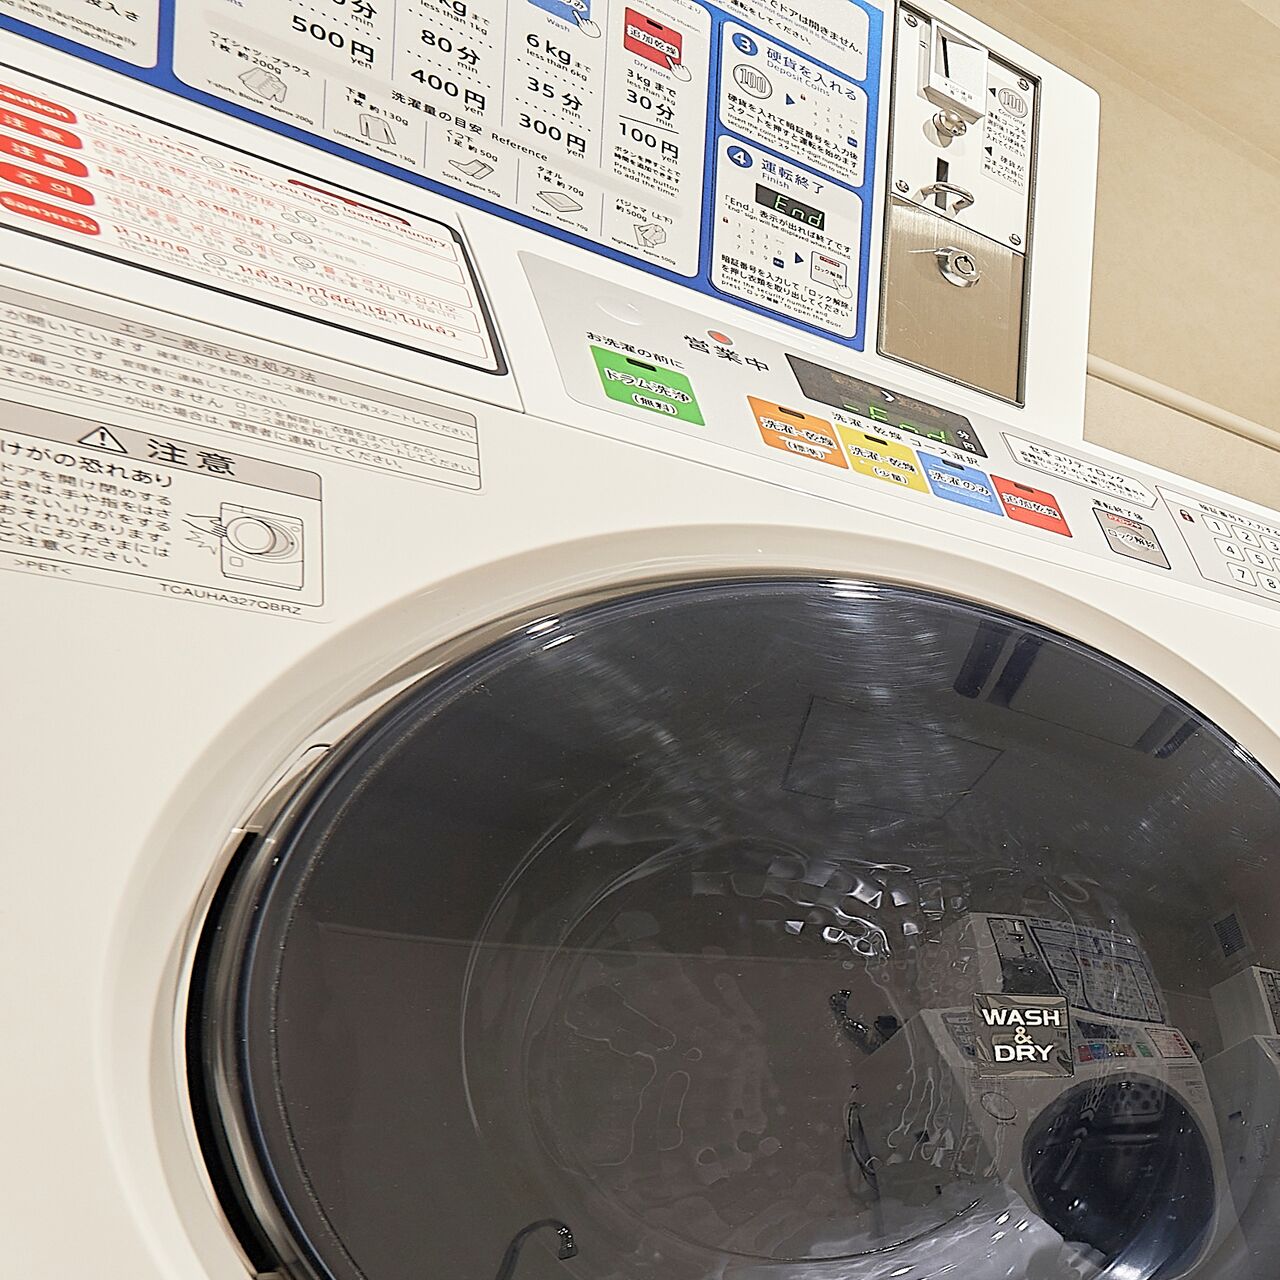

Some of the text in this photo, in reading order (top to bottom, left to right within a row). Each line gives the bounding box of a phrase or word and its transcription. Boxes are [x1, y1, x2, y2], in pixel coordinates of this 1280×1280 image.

[351, 14, 374, 28] min
[443, 12, 466, 24] than
[470, 22, 488, 36] 1kg
[546, 17, 570, 33] Wash
[628, 26, 677, 57] 追加乾燥
[351, 57, 372, 69] yen
[457, 60, 479, 74] min
[526, 48, 588, 81] less than 6kg
[634, 59, 671, 81] Dry more
[766, 47, 857, 101] 硬貨を入れる
[626, 78, 642, 90] less
[643, 84, 660, 98] than
[739, 68, 767, 94] 100
[767, 61, 830, 97] Deposit Coins
[464, 104, 484, 117] yen
[561, 106, 581, 119] min
[655, 116, 674, 129] min
[390, 89, 548, 162] 洗濯量の目安 Reference
[446, 129, 474, 143] くつ下
[566, 148, 585, 159] yen
[986, 134, 1026, 158] 入れてください
[614, 144, 682, 177] ボタンを押すことで
[661, 154, 679, 165] yen
[83, 113, 447, 249] Do not press after you have loaded laundry
[537, 165, 562, 180] タオル
[613, 168, 622, 176] to
[625, 174, 640, 182] add
[642, 180, 655, 189] the
[638, 171, 651, 180] the
[653, 178, 680, 193] button
[761, 158, 825, 194] 運転終了
[762, 172, 790, 190] Finish
[984, 164, 1024, 187] 押してください
[773, 194, 823, 228] End
[814, 264, 843, 280] ロック解除
[721, 264, 849, 318] を押し衣類を取り出してください
[721, 273, 829, 318] Enter the security number and
[118, 322, 318, 384] エラー表示と対処方法
[586, 331, 685, 370] お洗濯の前に
[684, 335, 769, 371] 営業中
[606, 369, 690, 402] ドラム洗浄
[1, 440, 174, 488] けがの恐れあり
[147, 438, 236, 476] 注意
[1029, 445, 1124, 483] セキュリティロック
[1, 462, 172, 505] ドアを開け閉めする
[931, 469, 990, 497] 洗濯のみ
[1199, 502, 1280, 537] 暗証番号を入力する
[0, 518, 170, 557] とくにお子さまには
[1213, 520, 1222, 532] 1
[1242, 530, 1252, 542] 2
[1271, 541, 1279, 552] 3
[1225, 544, 1235, 556] 4
[1255, 553, 1265, 564] 5
[1237, 568, 1245, 579] 7
[1267, 578, 1277, 589] 8
[160, 583, 302, 616] TCAUHA327QBRZ
[982, 1009, 1061, 1026] WASH
[1014, 1027, 1034, 1044] &
[994, 1044, 1053, 1062] DRY
